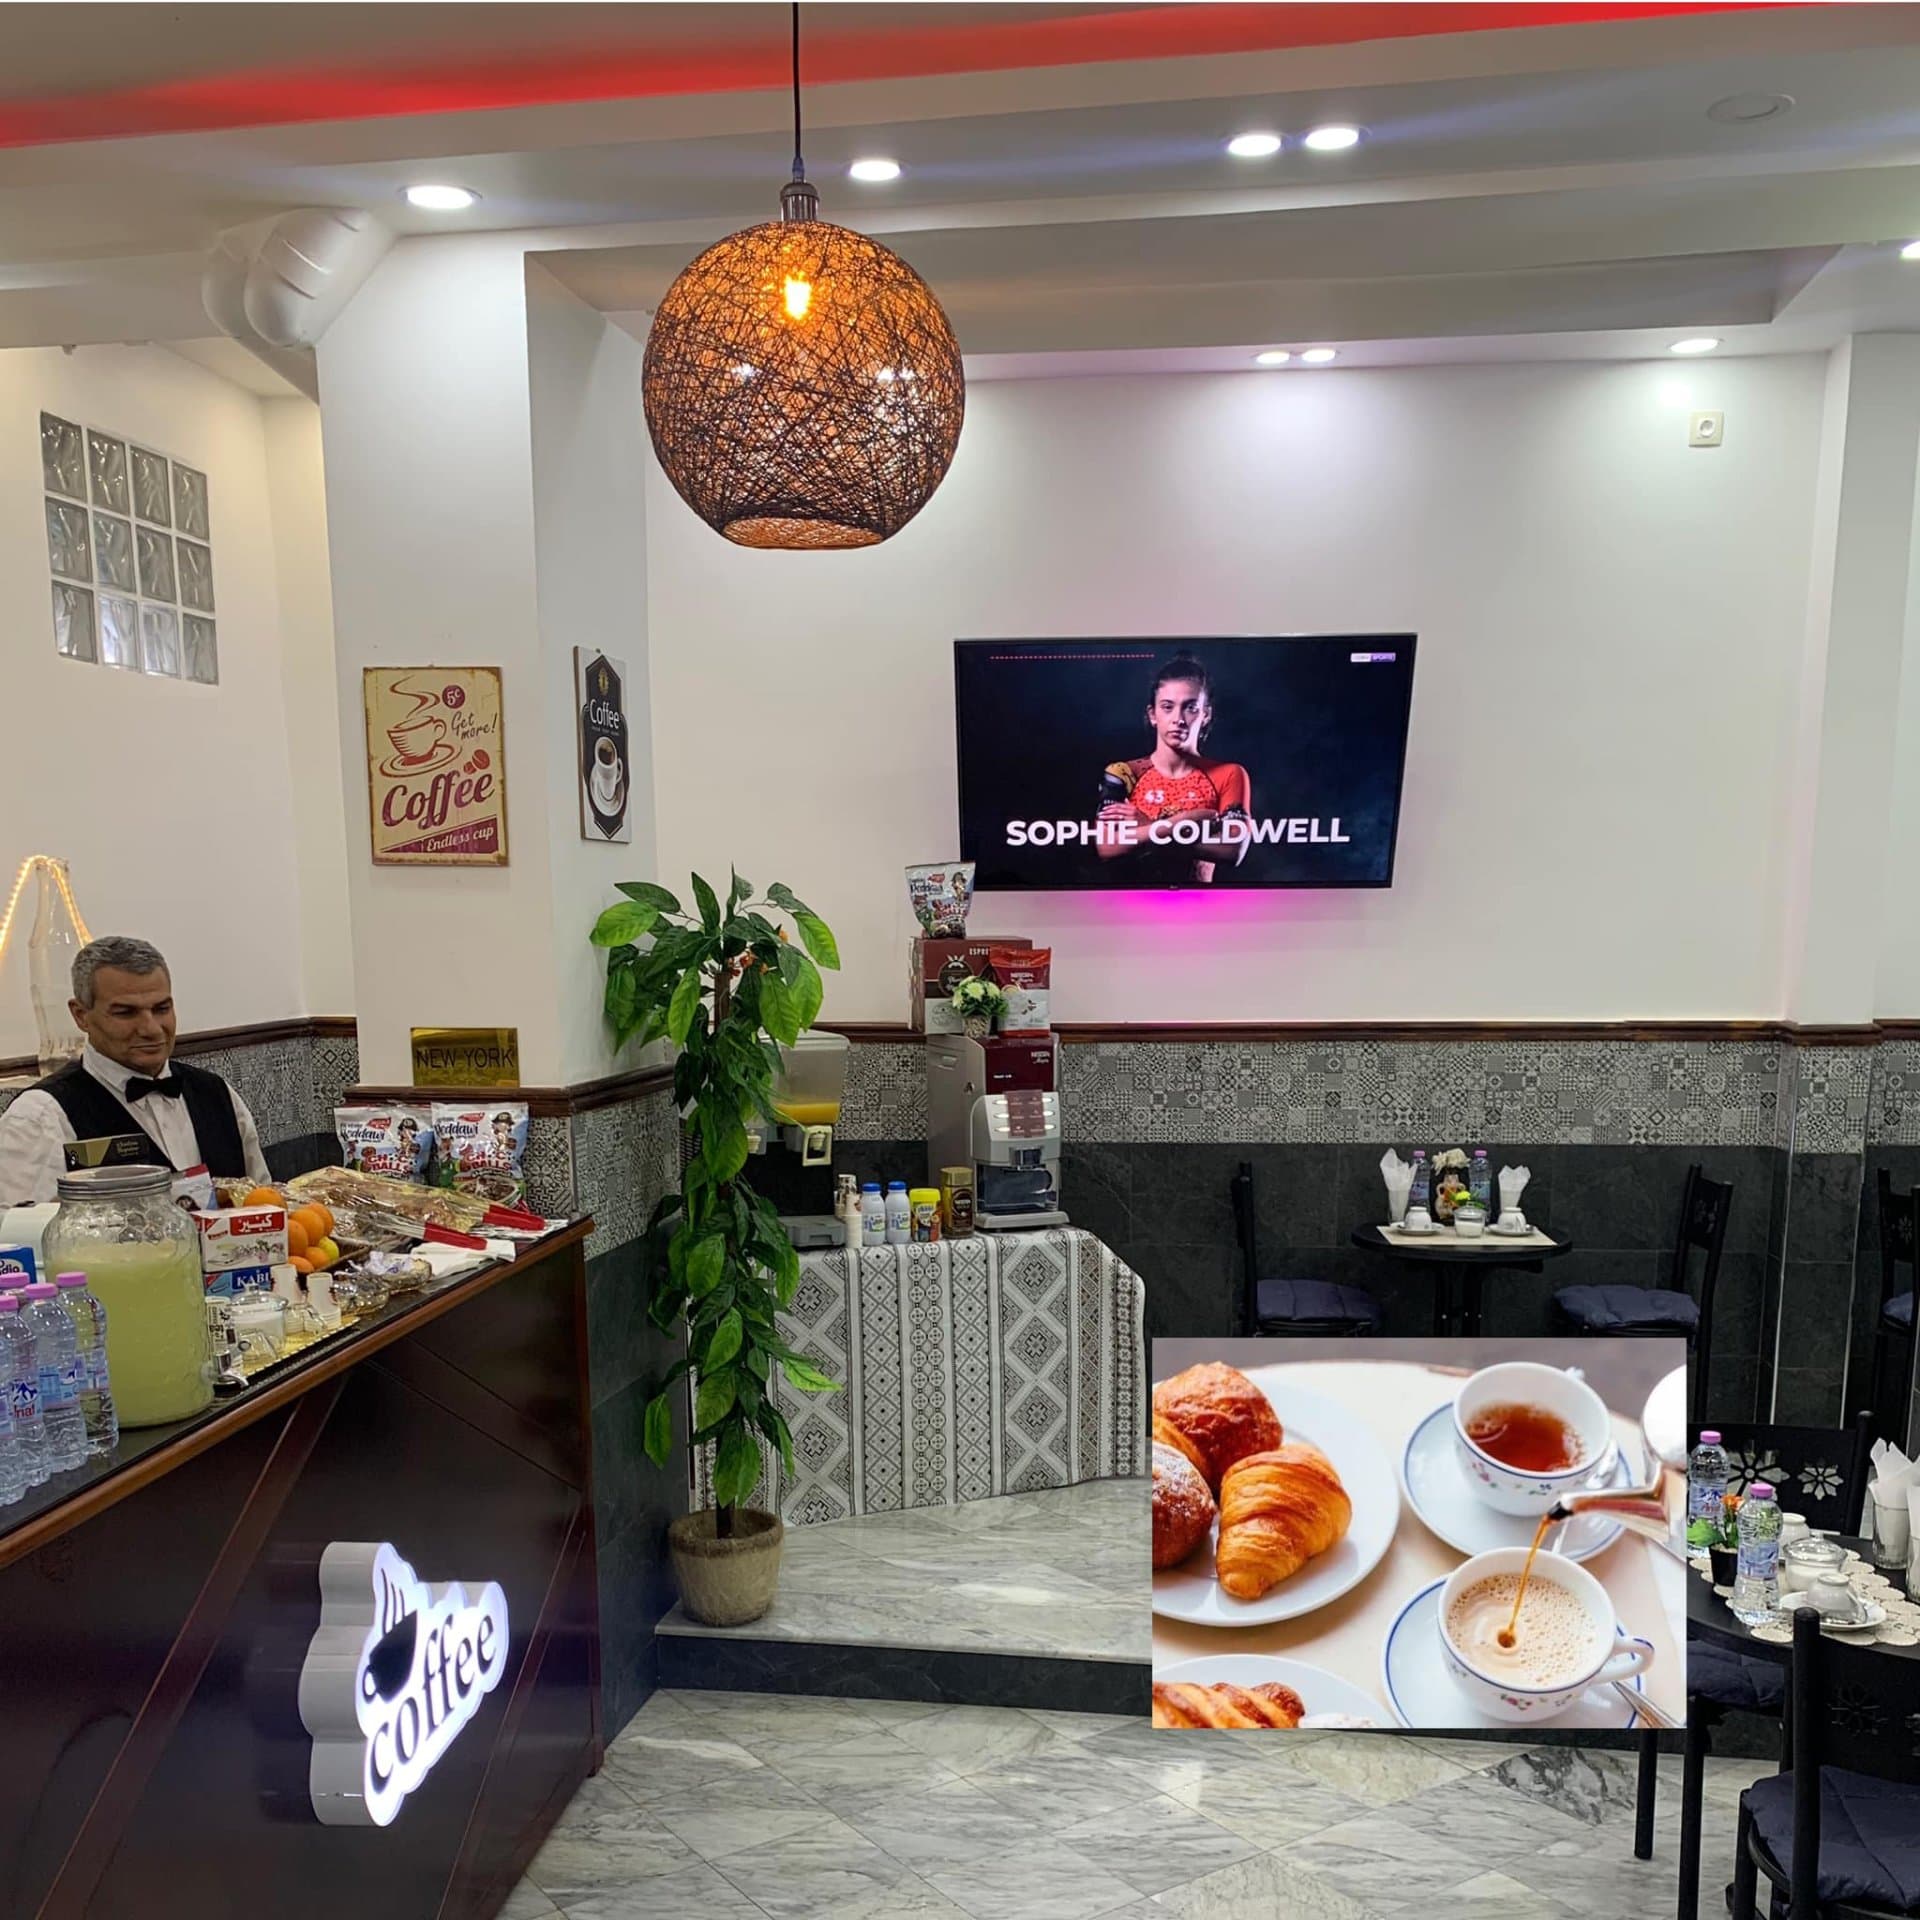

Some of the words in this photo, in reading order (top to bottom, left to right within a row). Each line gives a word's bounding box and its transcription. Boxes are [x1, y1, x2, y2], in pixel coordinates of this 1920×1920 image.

[451, 711, 475, 737] Get
[460, 711, 498, 740] more!
[590, 698, 620, 729] Coffee
[382, 770, 496, 830] Coffee
[426, 833, 470, 852] Endless
[472, 826, 494, 841] cup
[1006, 819, 1139, 846] SOPHIE
[1148, 817, 1351, 845] COLDWELL
[415, 1047, 457, 1069] NEW
[463, 1046, 514, 1069] YORK
[236, 1272, 270, 1288] KABI
[370, 1612, 497, 1795] coffee
